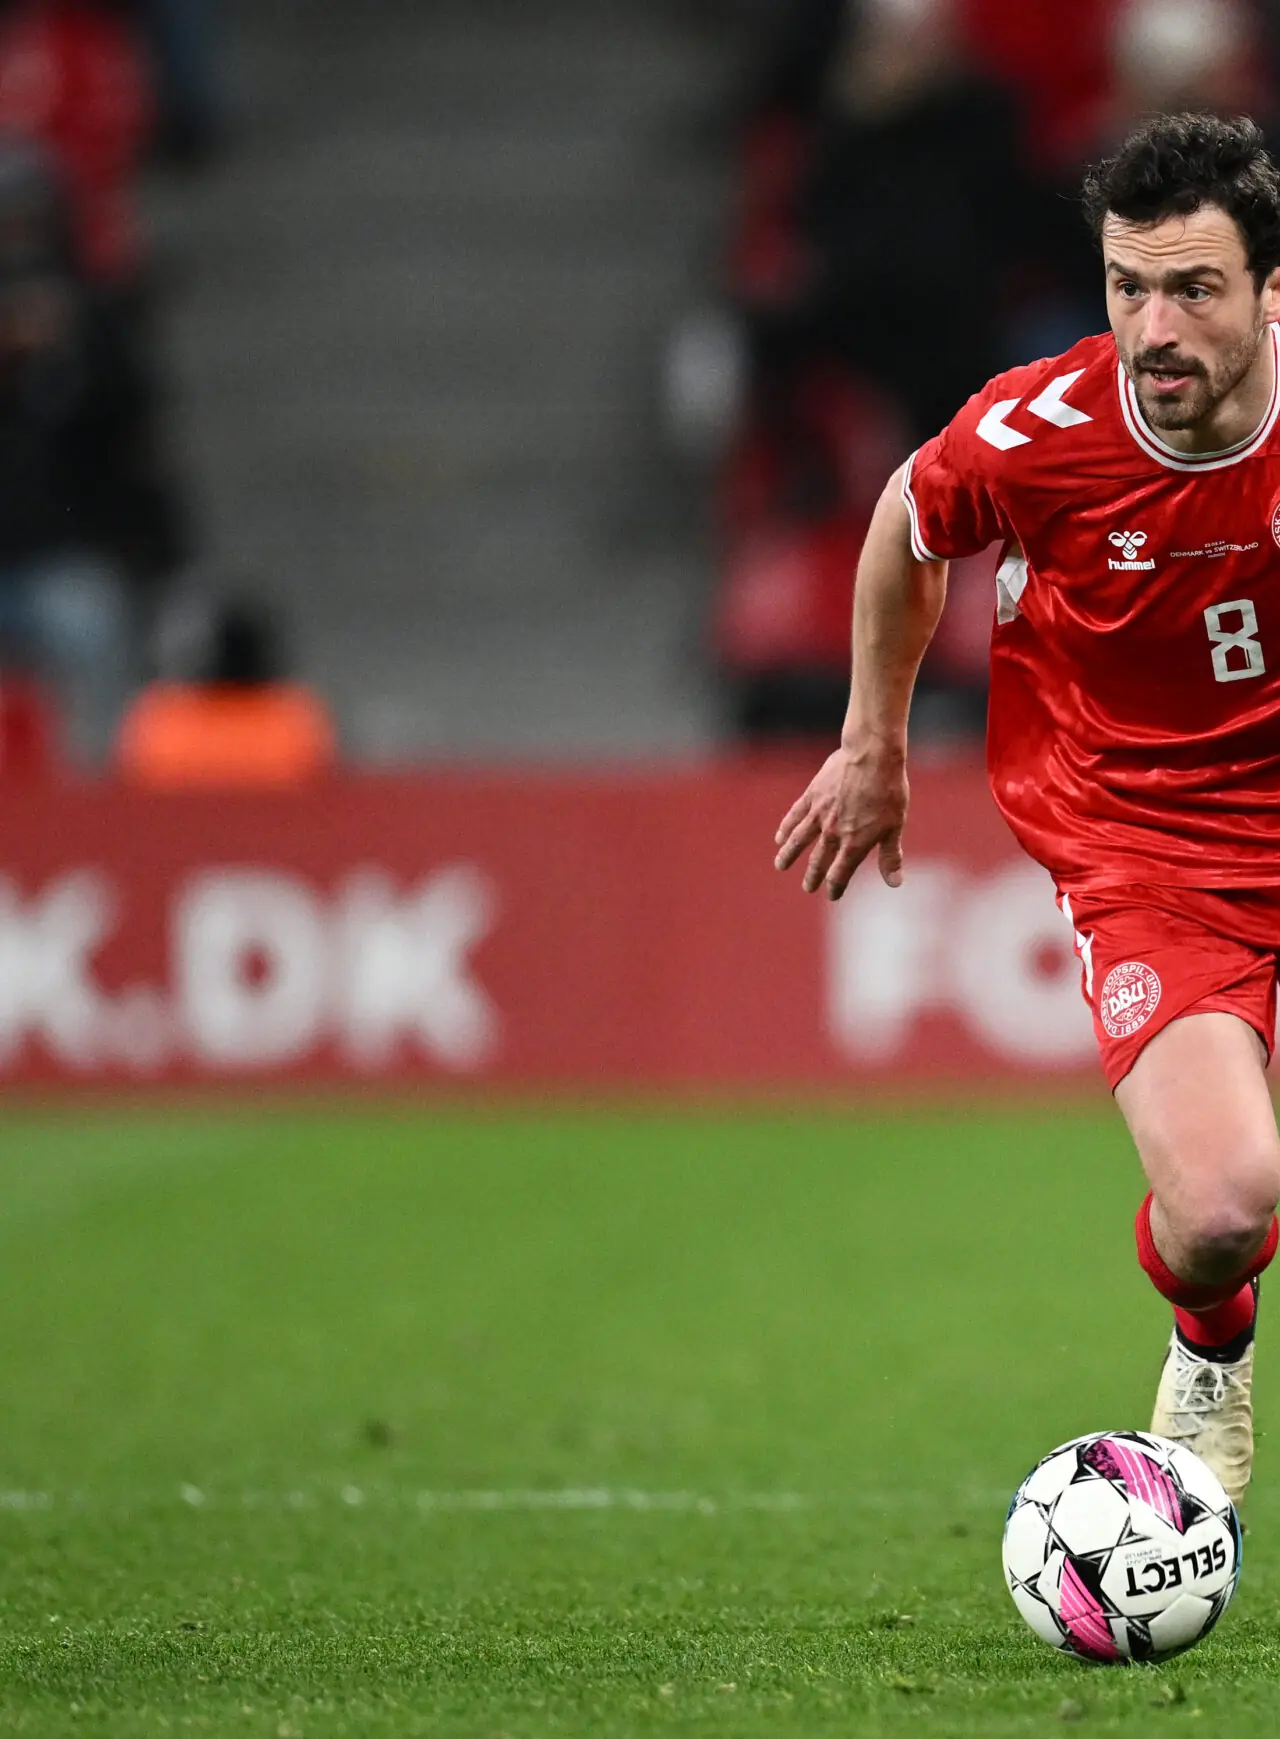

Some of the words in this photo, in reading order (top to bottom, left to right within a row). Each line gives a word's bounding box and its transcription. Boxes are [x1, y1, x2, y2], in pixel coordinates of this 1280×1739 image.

[1108, 558, 1155, 570] hummel
[1169, 549, 1204, 558] DENMARK
[1213, 541, 1259, 552] SWITZERLAND
[1203, 599, 1266, 682] 8
[1108, 981, 1147, 1018] DBU
[1144, 974, 1159, 1012] UNION
[1126, 1537, 1226, 1597] SELECT
